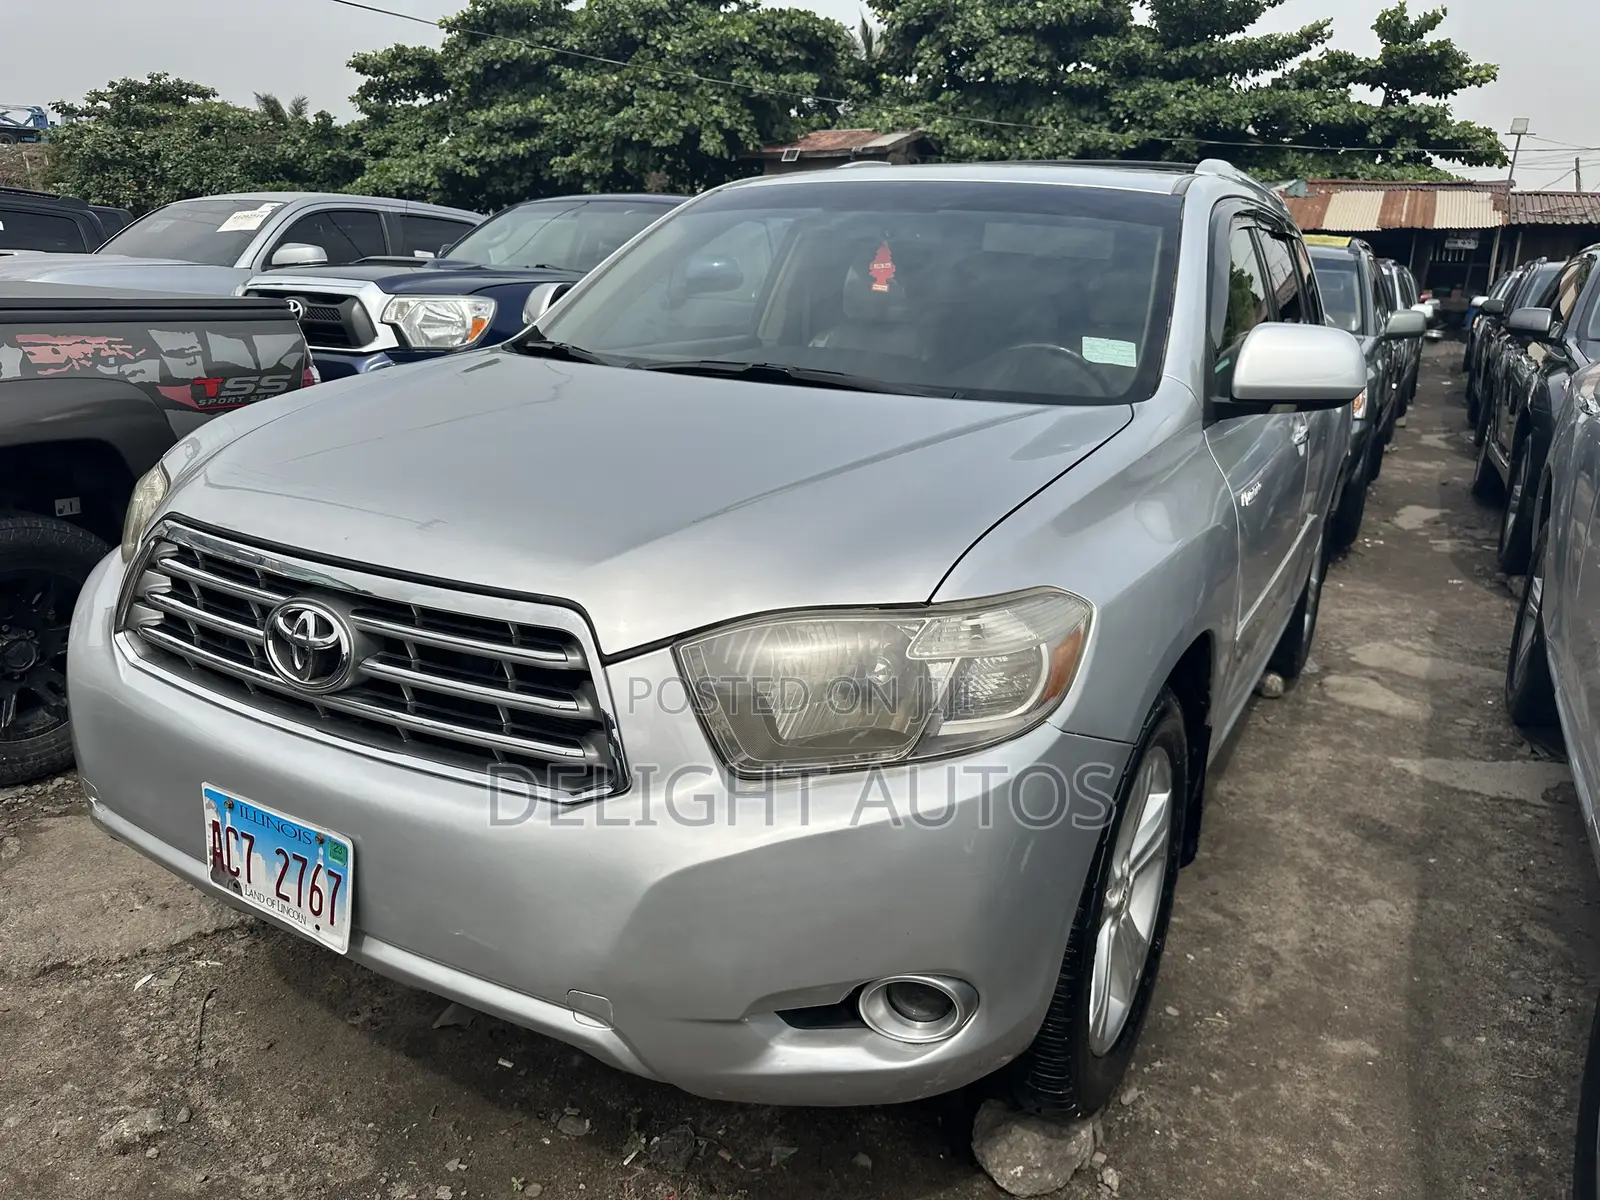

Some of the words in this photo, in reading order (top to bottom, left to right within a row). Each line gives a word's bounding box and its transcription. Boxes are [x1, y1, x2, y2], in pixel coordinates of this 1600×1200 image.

[194, 375, 291, 397] TSS
[198, 396, 245, 406] SPORT
[239, 804, 312, 846] ILLINOIS
[211, 819, 255, 884] AC7
[274, 848, 342, 926] 2767
